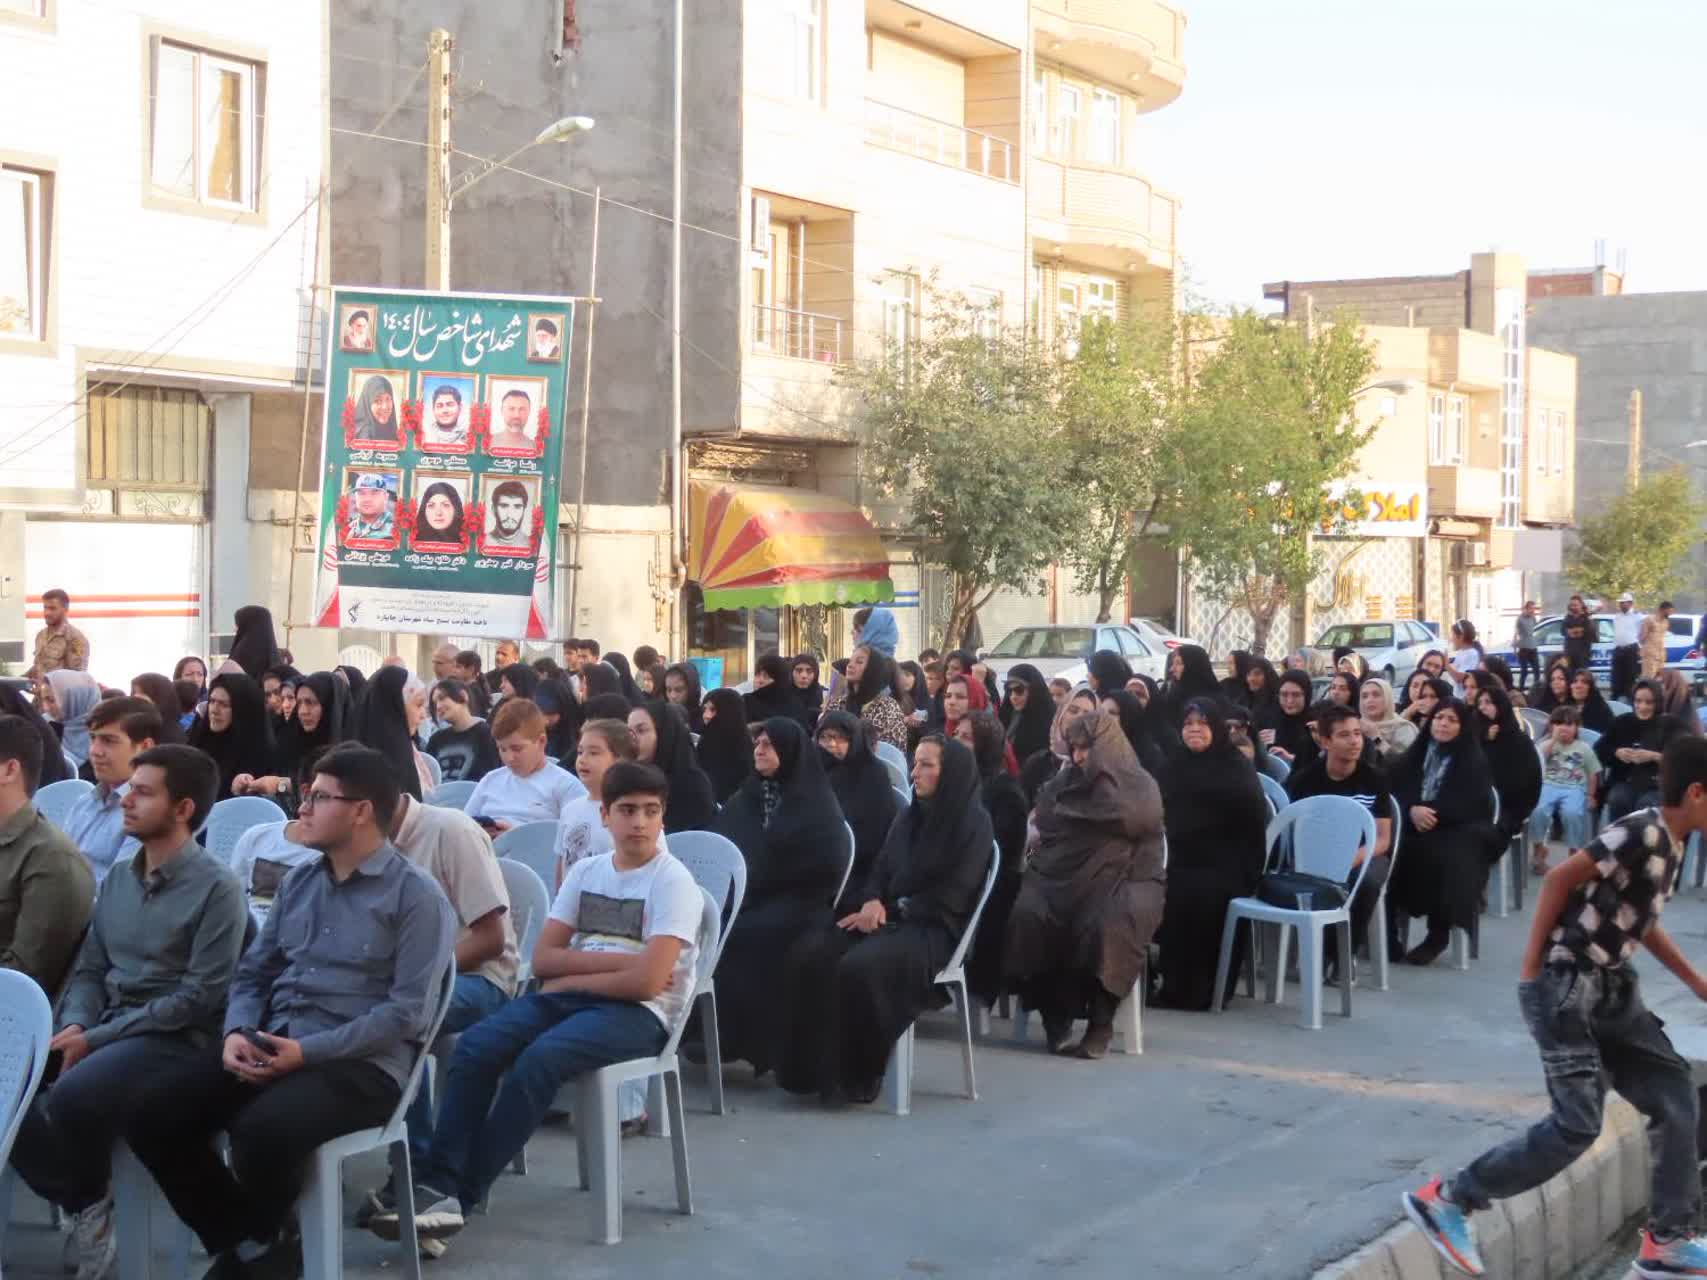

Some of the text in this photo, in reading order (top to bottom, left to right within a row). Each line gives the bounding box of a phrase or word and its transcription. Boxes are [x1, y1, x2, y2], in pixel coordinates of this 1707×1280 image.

[389, 305, 438, 358] سال
[413, 311, 483, 362] شاخص
[462, 313, 521, 367] شهدای
